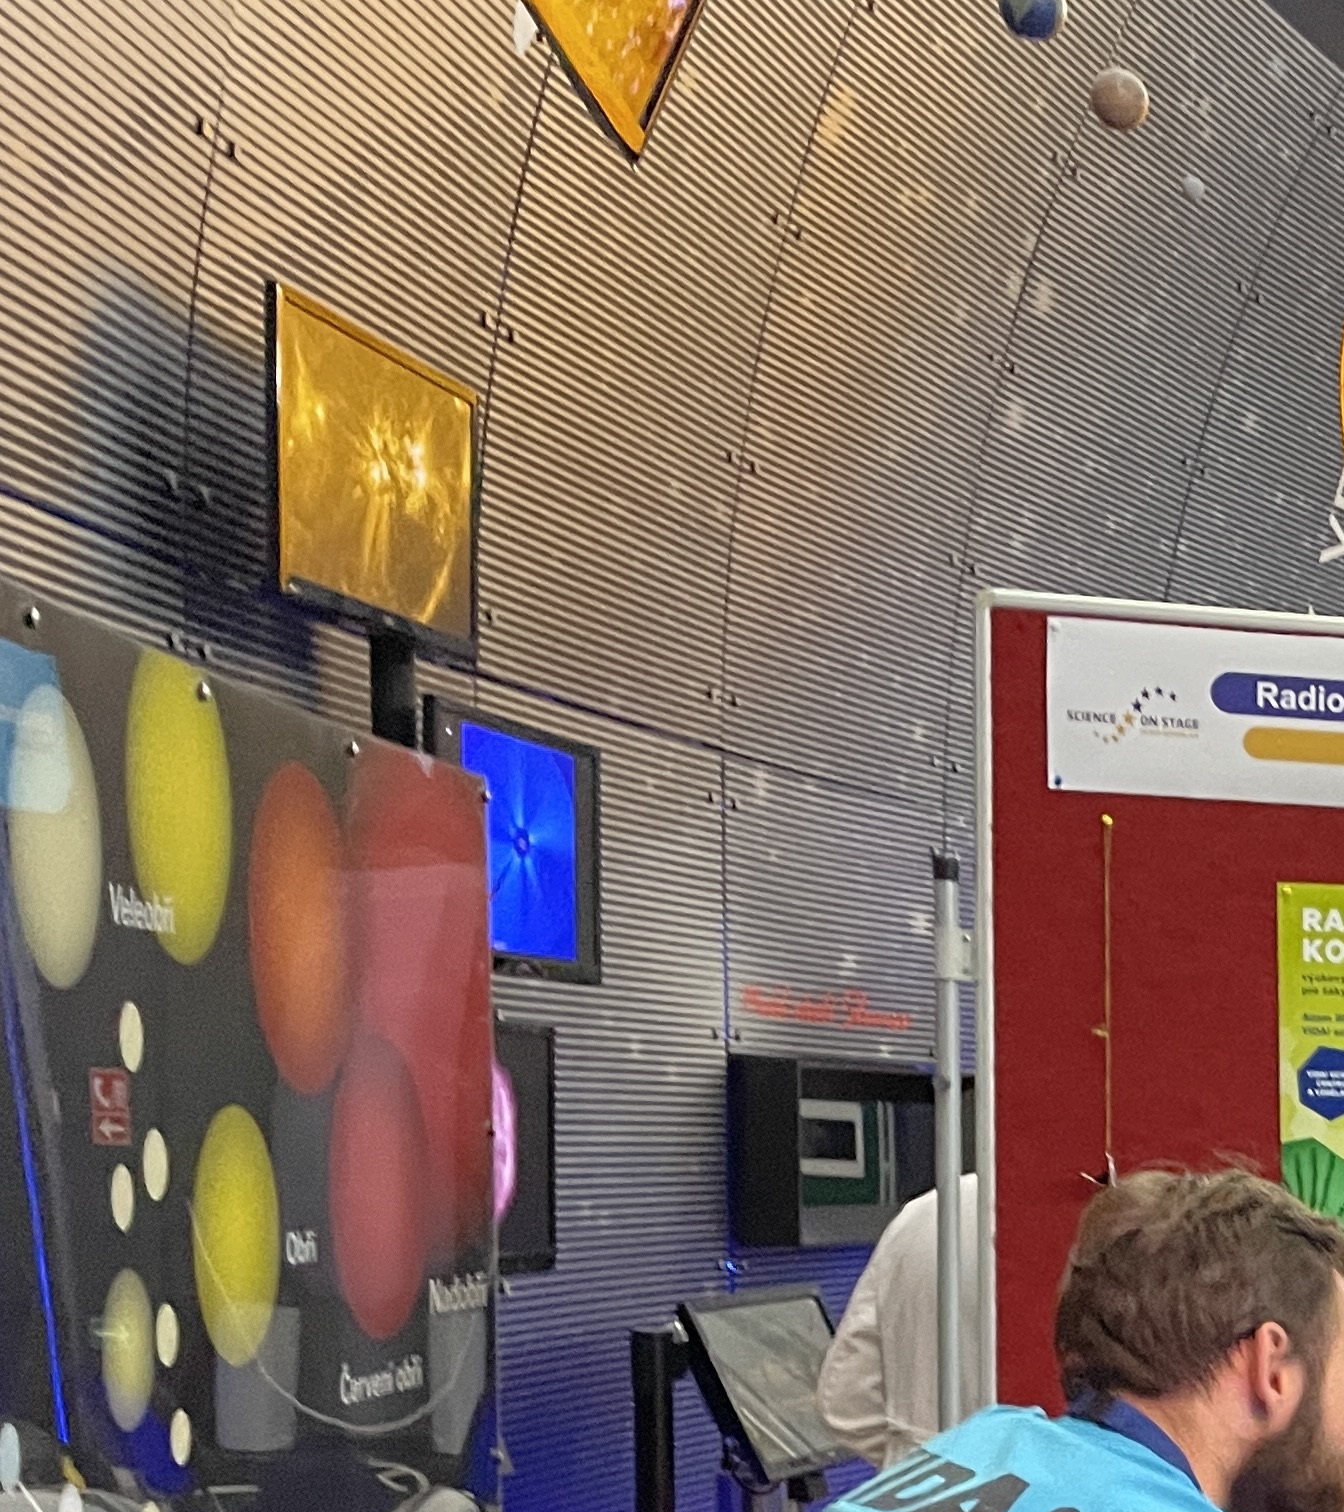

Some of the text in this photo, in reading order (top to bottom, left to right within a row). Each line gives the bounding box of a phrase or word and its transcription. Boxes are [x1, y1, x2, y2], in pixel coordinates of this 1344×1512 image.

[1066, 708, 1199, 730] SCIENCE ON STAGE
